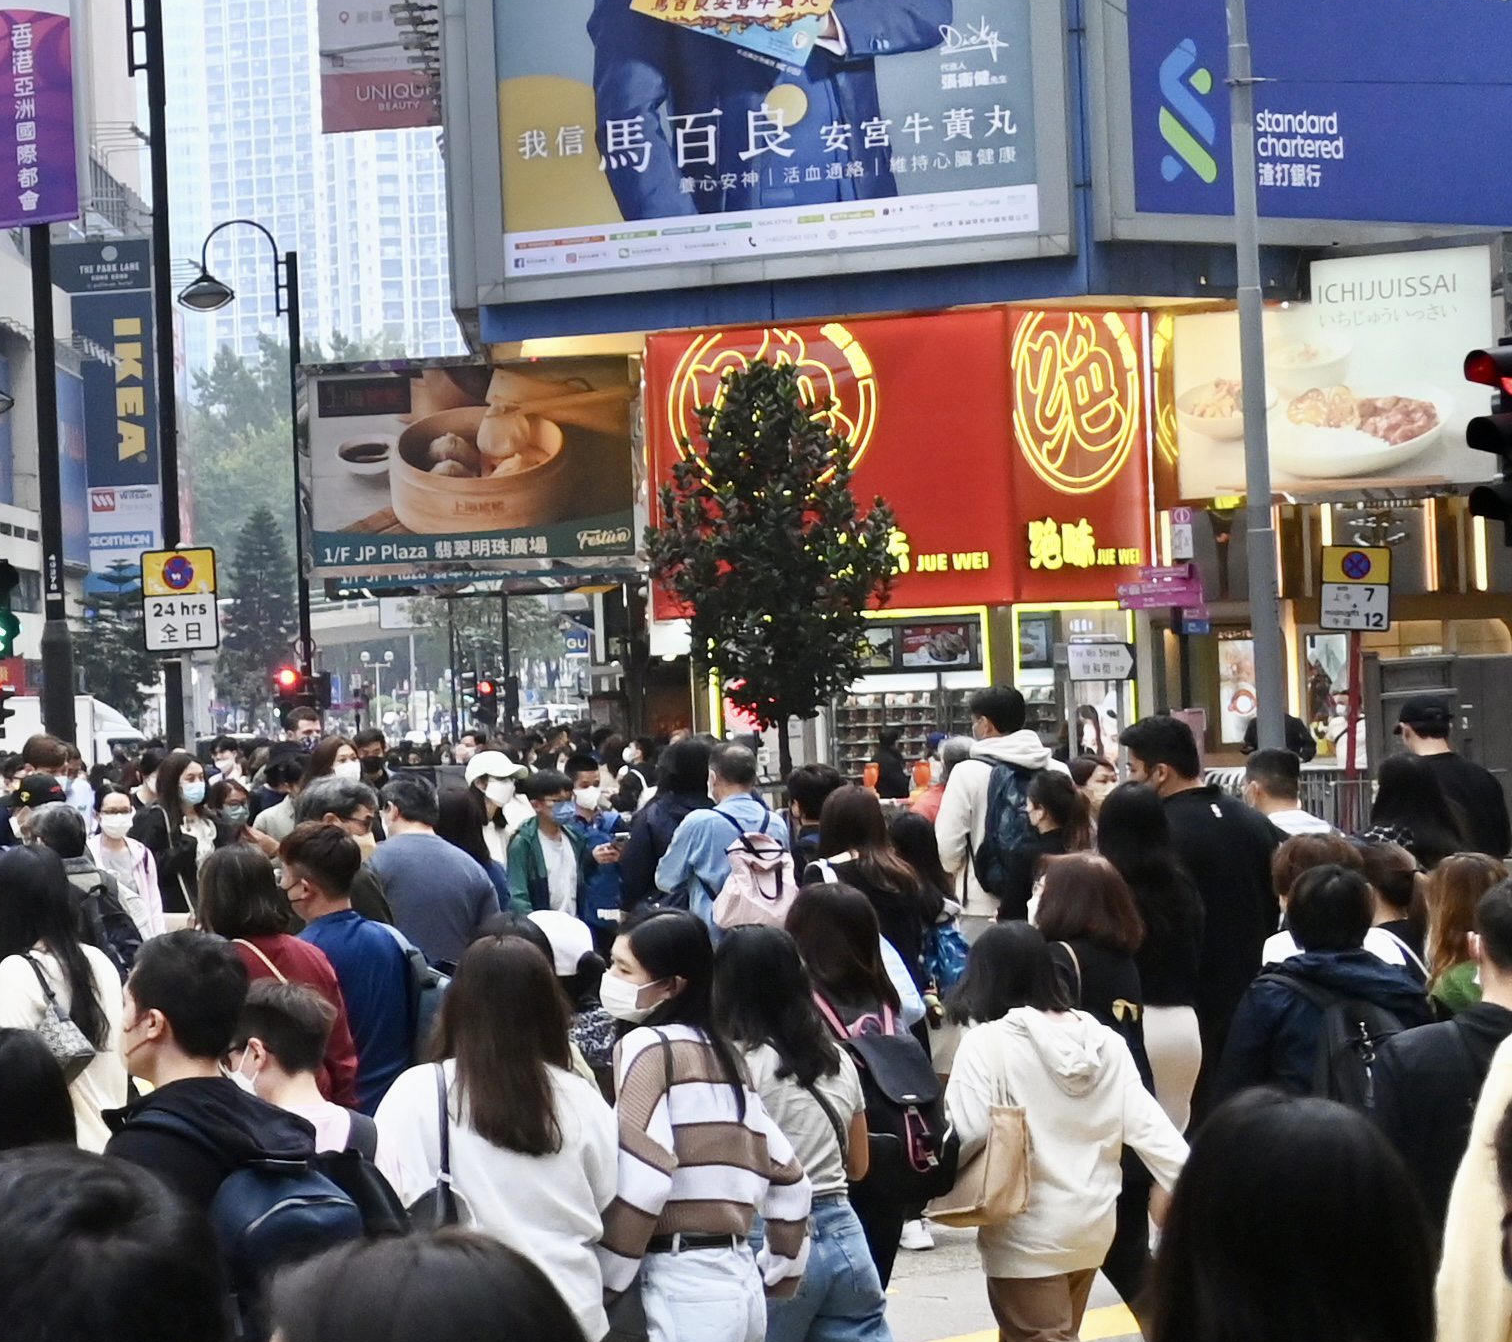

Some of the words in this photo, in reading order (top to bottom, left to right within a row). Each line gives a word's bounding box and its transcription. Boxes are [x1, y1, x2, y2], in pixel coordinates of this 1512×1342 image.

[377, 99, 421, 112] BEAUTY
[9, 22, 41, 214] 香港亞洲國際都會
[1257, 109, 1338, 136] standard
[518, 123, 585, 161] 我信
[599, 101, 795, 173] 馬百良
[819, 104, 1019, 153] 安宮牛黃丸
[1257, 134, 1344, 160] chartered
[783, 157, 866, 185] 活血通絡
[1259, 164, 1321, 188] 渣打銀行
[119, 261, 141, 273] LANE
[1316, 271, 1459, 305] ICHIJUISSAI
[113, 317, 148, 462] IKEA
[323, 548, 351, 564] 1/F
[354, 546, 381, 562] JP
[381, 543, 428, 560] Plaza
[434, 536, 548, 559] 翡翠明珠廣場
[952, 551, 990, 572] WEI
[1096, 548, 1117, 566] JUE
[1118, 546, 1141, 566] WEI
[1364, 589, 1375, 603] 7
[153, 602, 177, 618] 24
[180, 602, 208, 617] hrs
[1363, 612, 1385, 628] 12
[160, 621, 202, 643] 全日
[565, 636, 589, 652] GU
